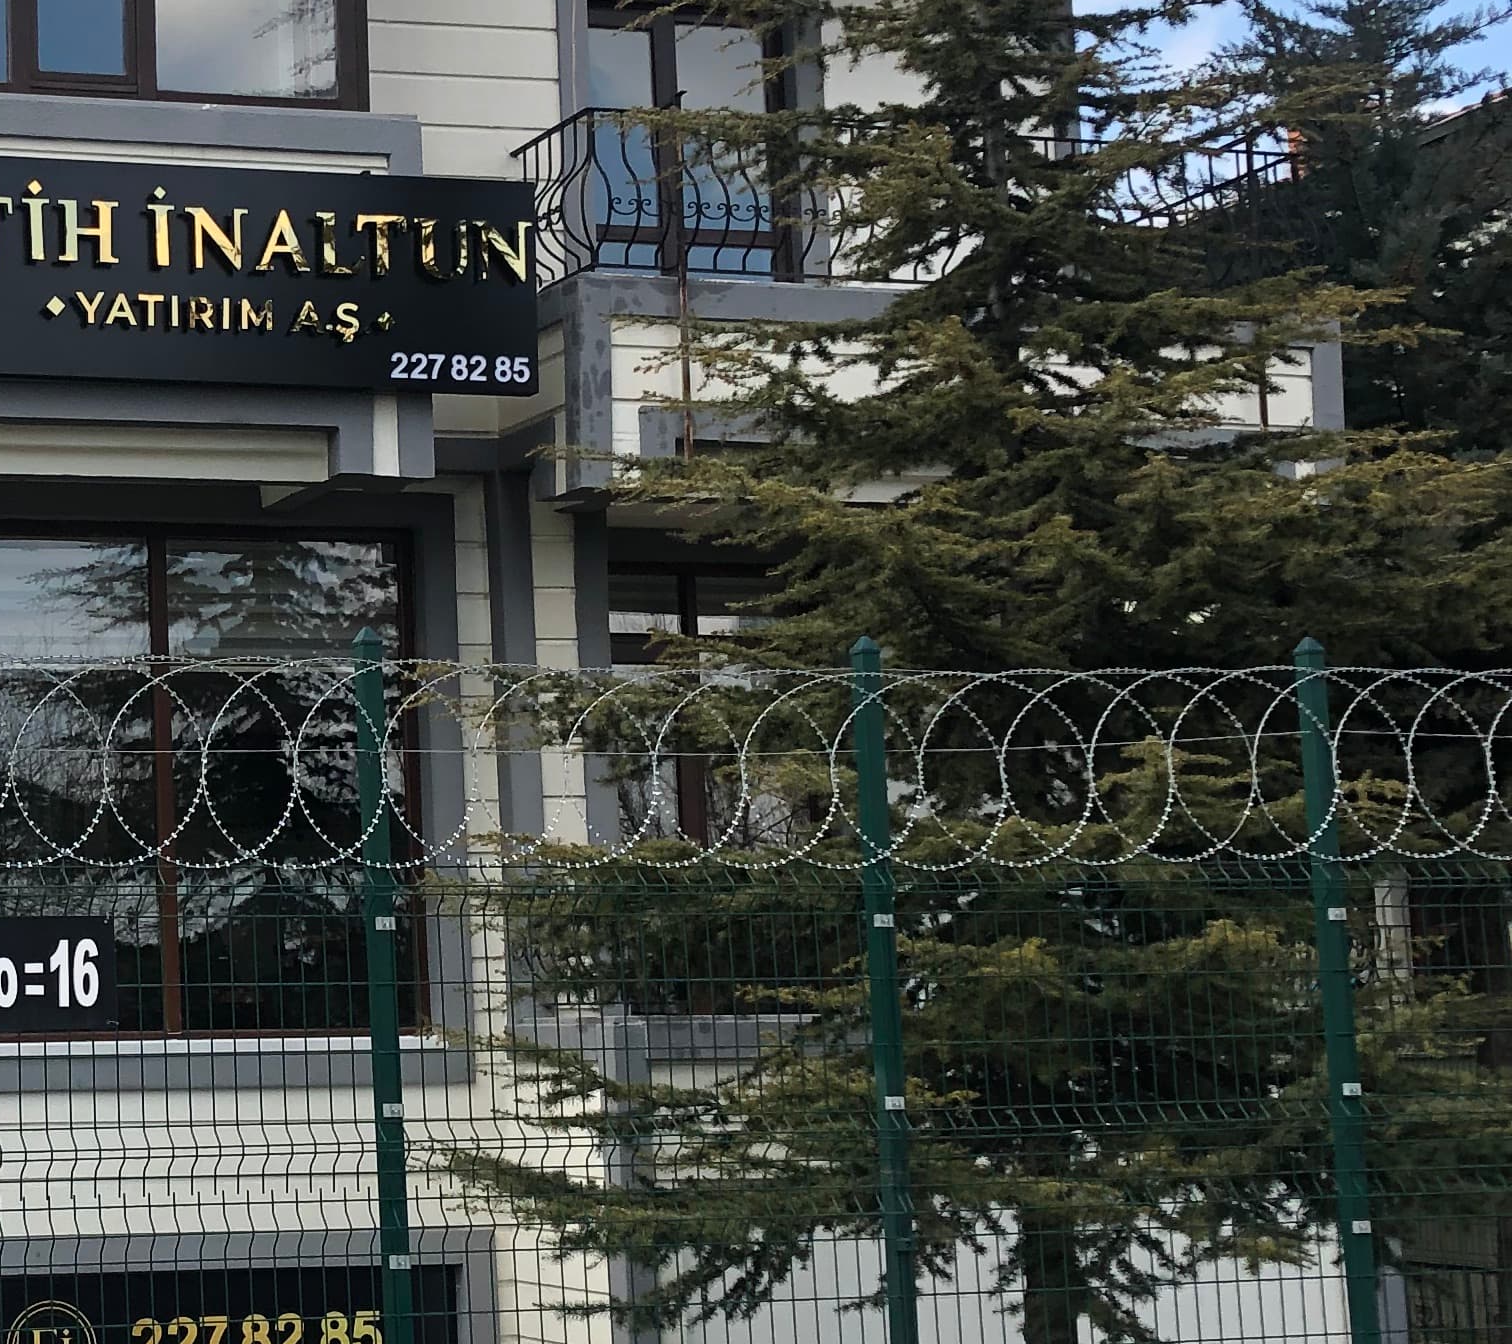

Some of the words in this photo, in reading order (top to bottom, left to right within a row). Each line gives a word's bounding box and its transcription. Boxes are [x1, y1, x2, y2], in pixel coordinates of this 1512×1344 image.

[146, 185, 534, 284] İNALTUN
[74, 290, 274, 332] YATIRIM
[390, 352, 446, 380] 227
[450, 354, 488, 383] 82
[494, 356, 531, 384] 85
